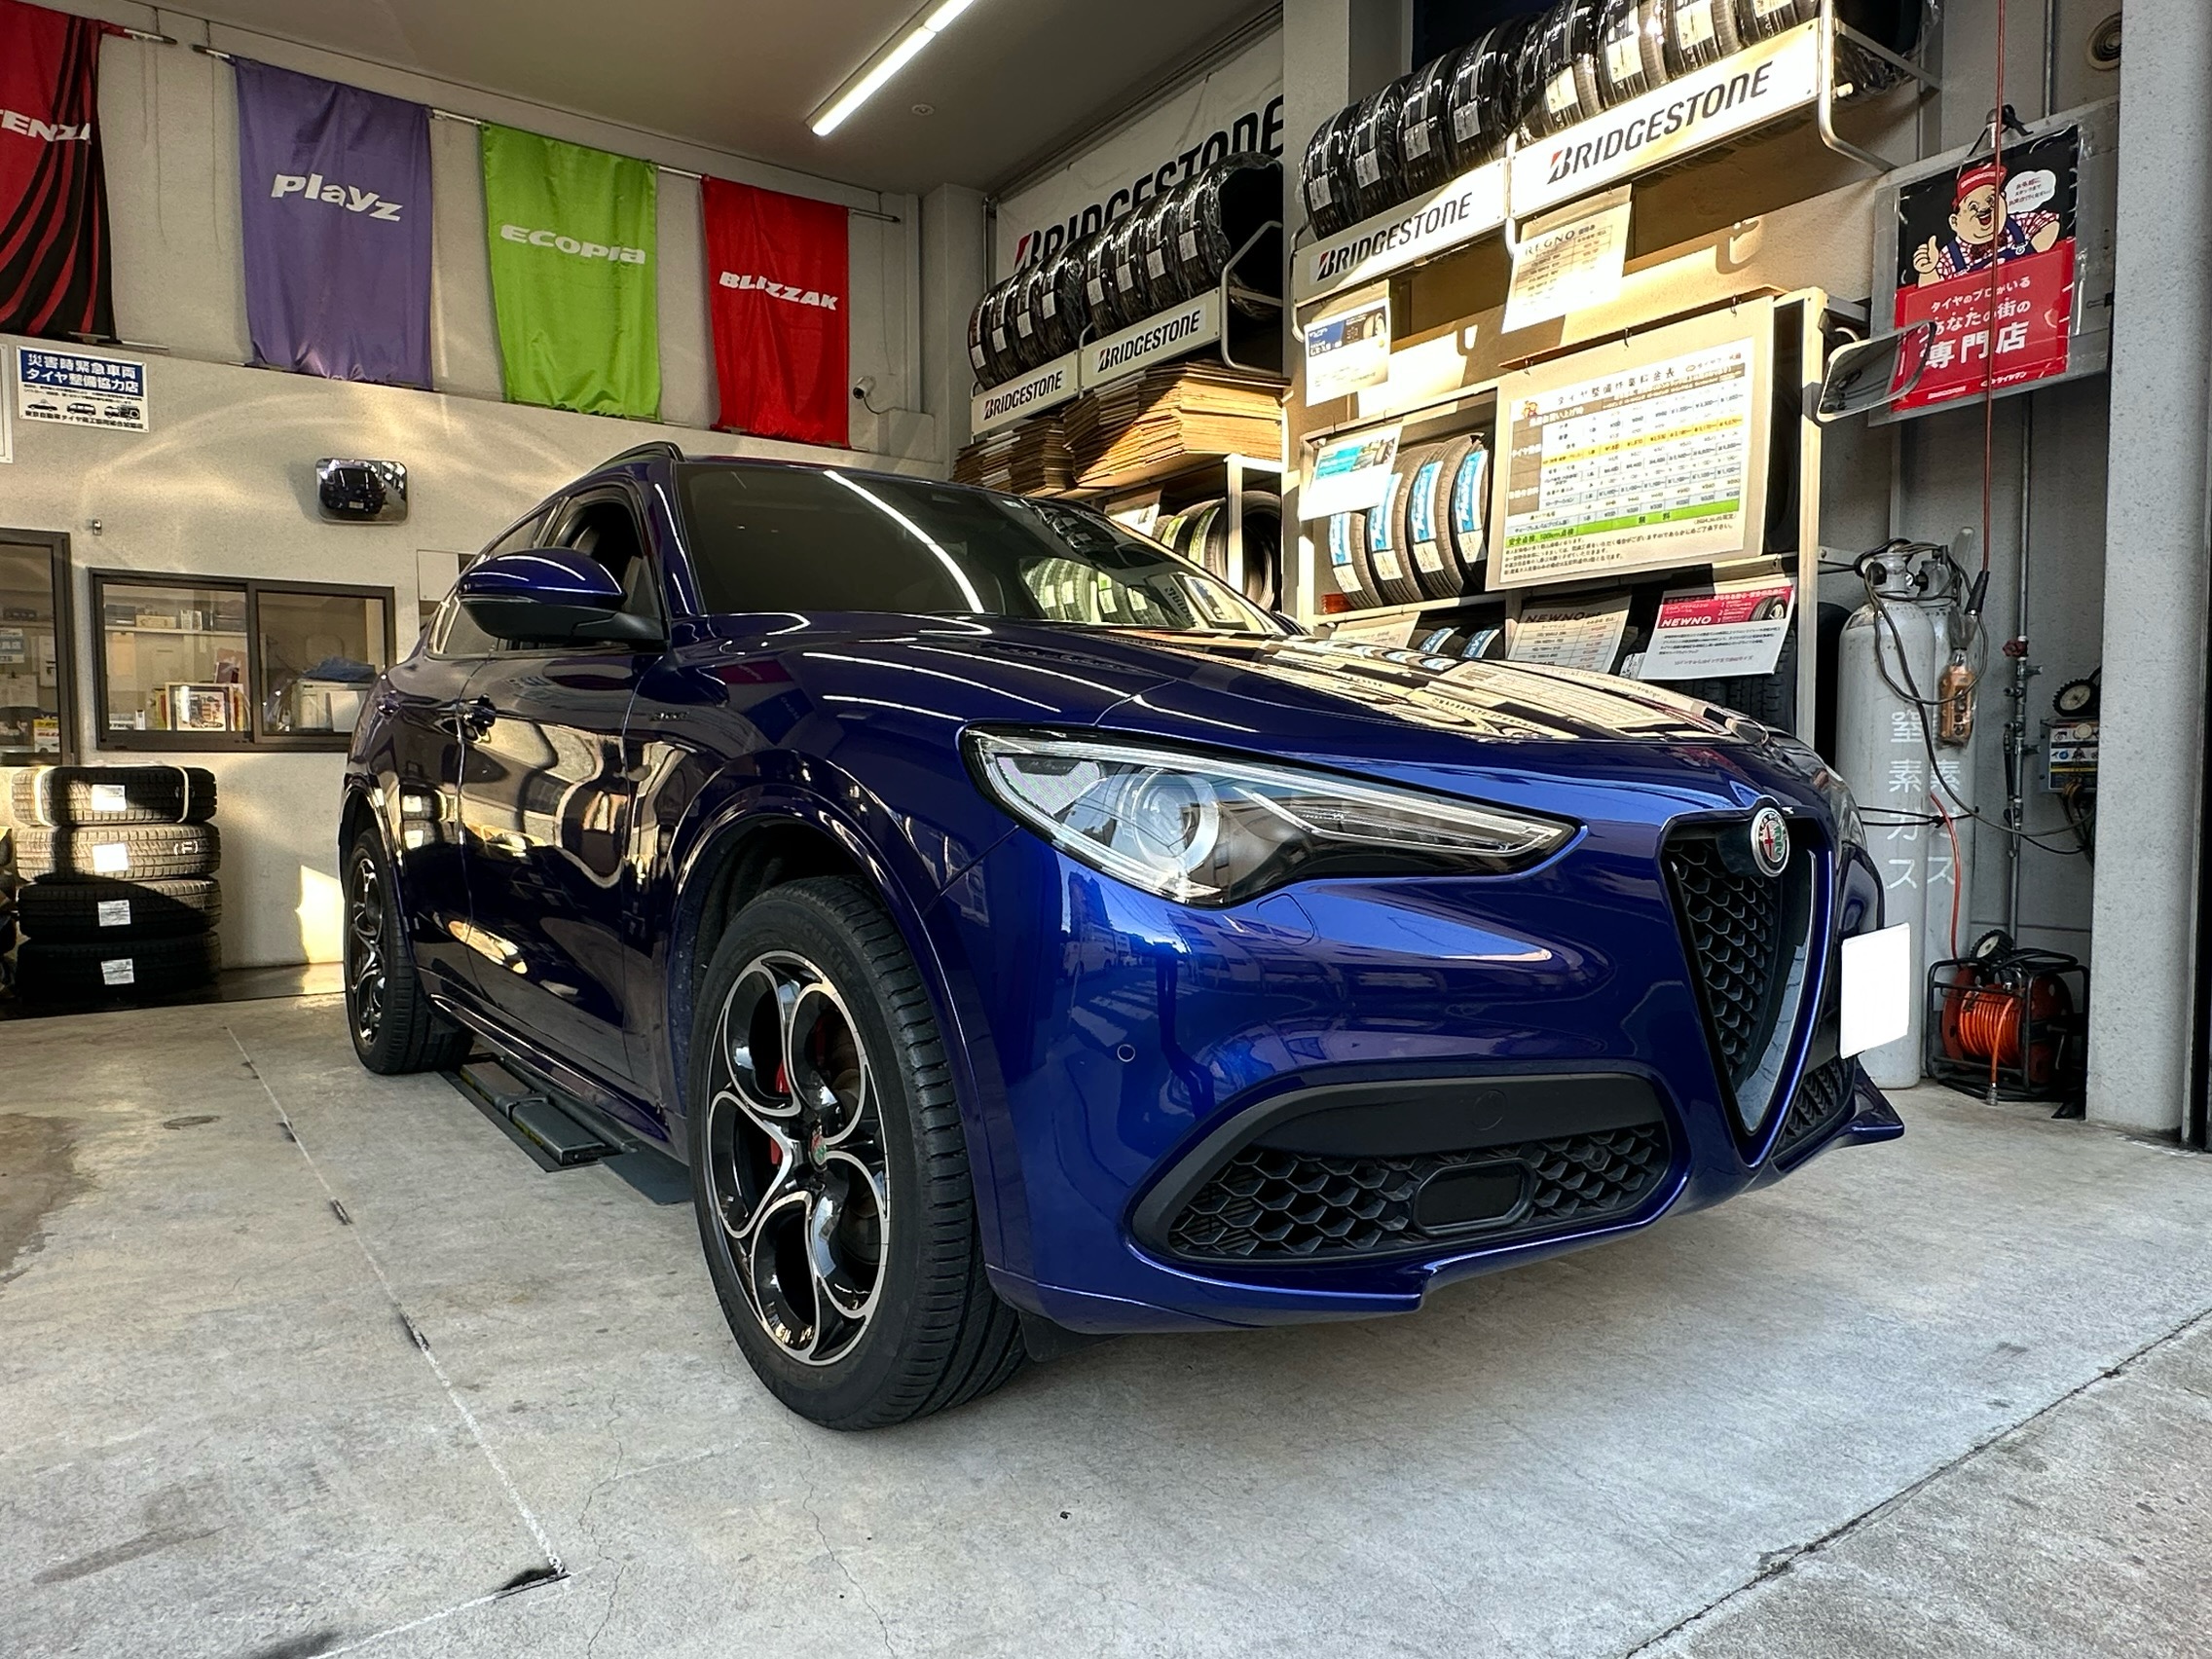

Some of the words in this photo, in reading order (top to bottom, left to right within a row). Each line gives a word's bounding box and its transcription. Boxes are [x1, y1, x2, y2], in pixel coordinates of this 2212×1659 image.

[1547, 60, 1774, 185] BRIDGESTONE
[1317, 192, 1473, 281] BRIDGESTONE
[719, 271, 838, 311] BLIZZAK
[1931, 276, 2031, 313] タイヤのプロがいる
[1097, 310, 1202, 373] BRIDGESTONE
[1925, 321, 2029, 369] 専門店
[983, 371, 1064, 421] BRIDGESTONE
[1525, 611, 1585, 623] NEWNO
[1661, 615, 1712, 628] NEWNO
[1887, 710, 1924, 890] 窒素ガス
